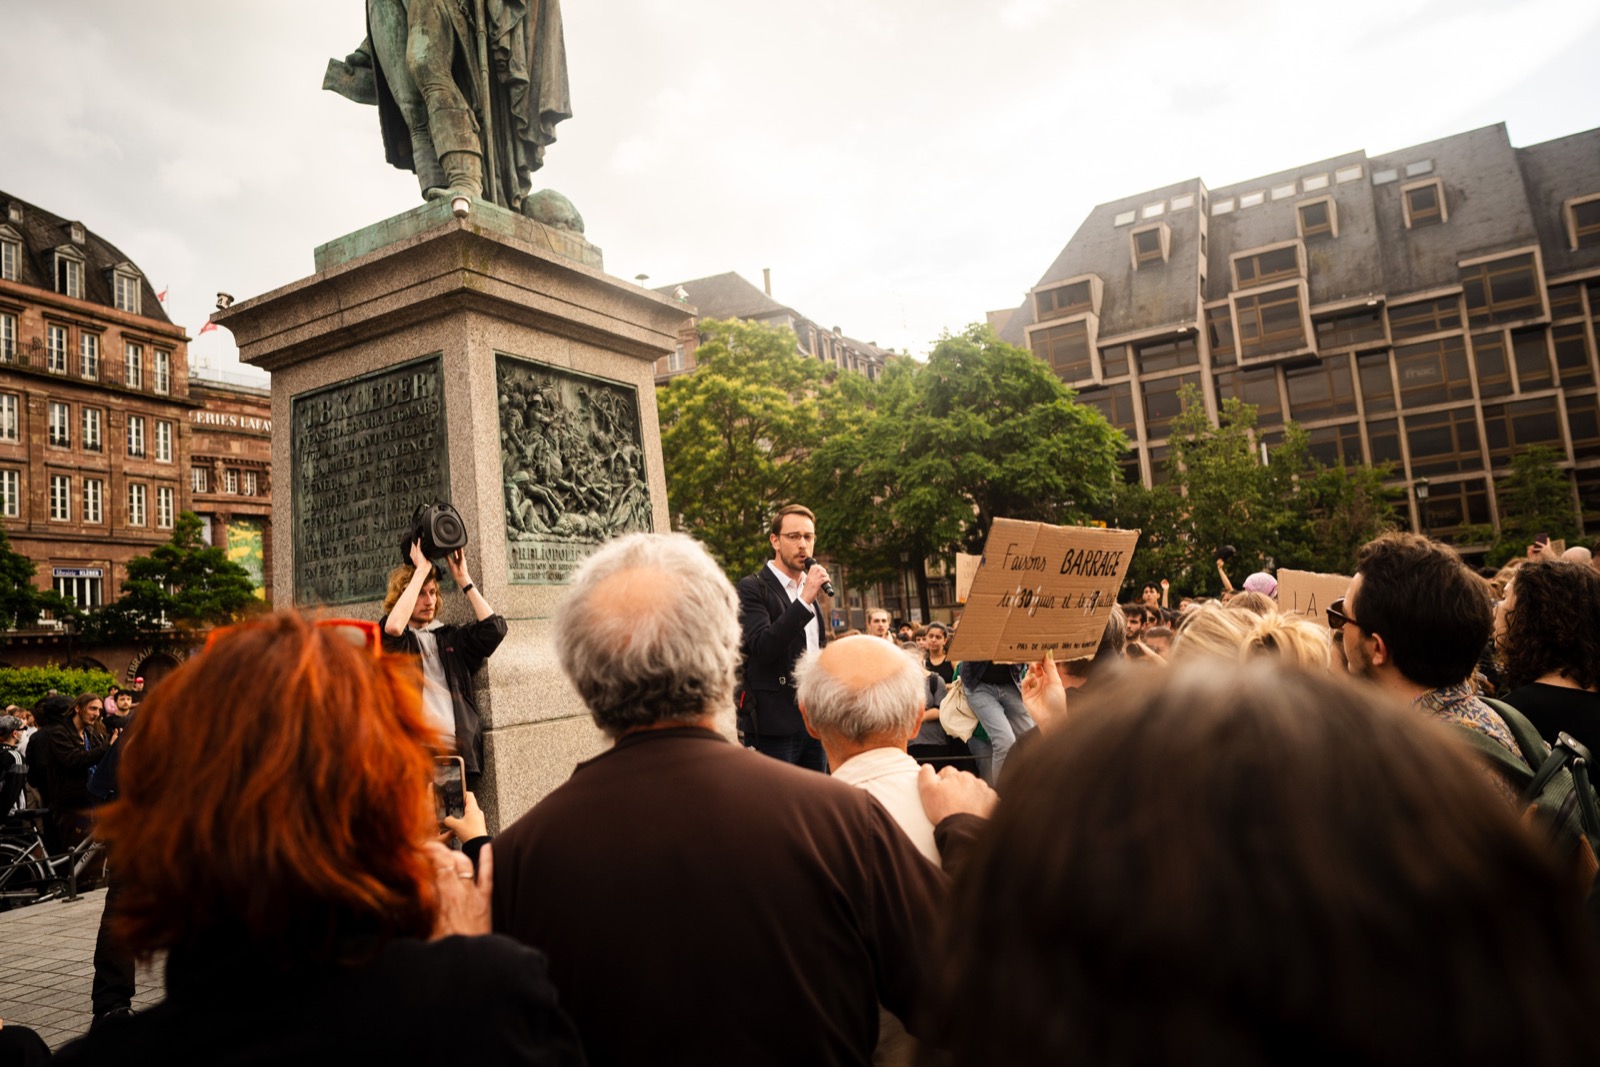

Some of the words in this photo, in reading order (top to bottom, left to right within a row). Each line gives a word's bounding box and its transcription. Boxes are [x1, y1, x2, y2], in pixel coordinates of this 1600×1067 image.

[373, 514, 412, 533] SAMBR
[1002, 543, 1047, 573] Faisons
[1060, 549, 1123, 577] BARRAGE
[1017, 588, 1032, 608] 30
[1028, 586, 1055, 617] juin
[1062, 593, 1072, 608] et
[1294, 591, 1317, 616] LA
[1016, 642, 1028, 651] PAS
